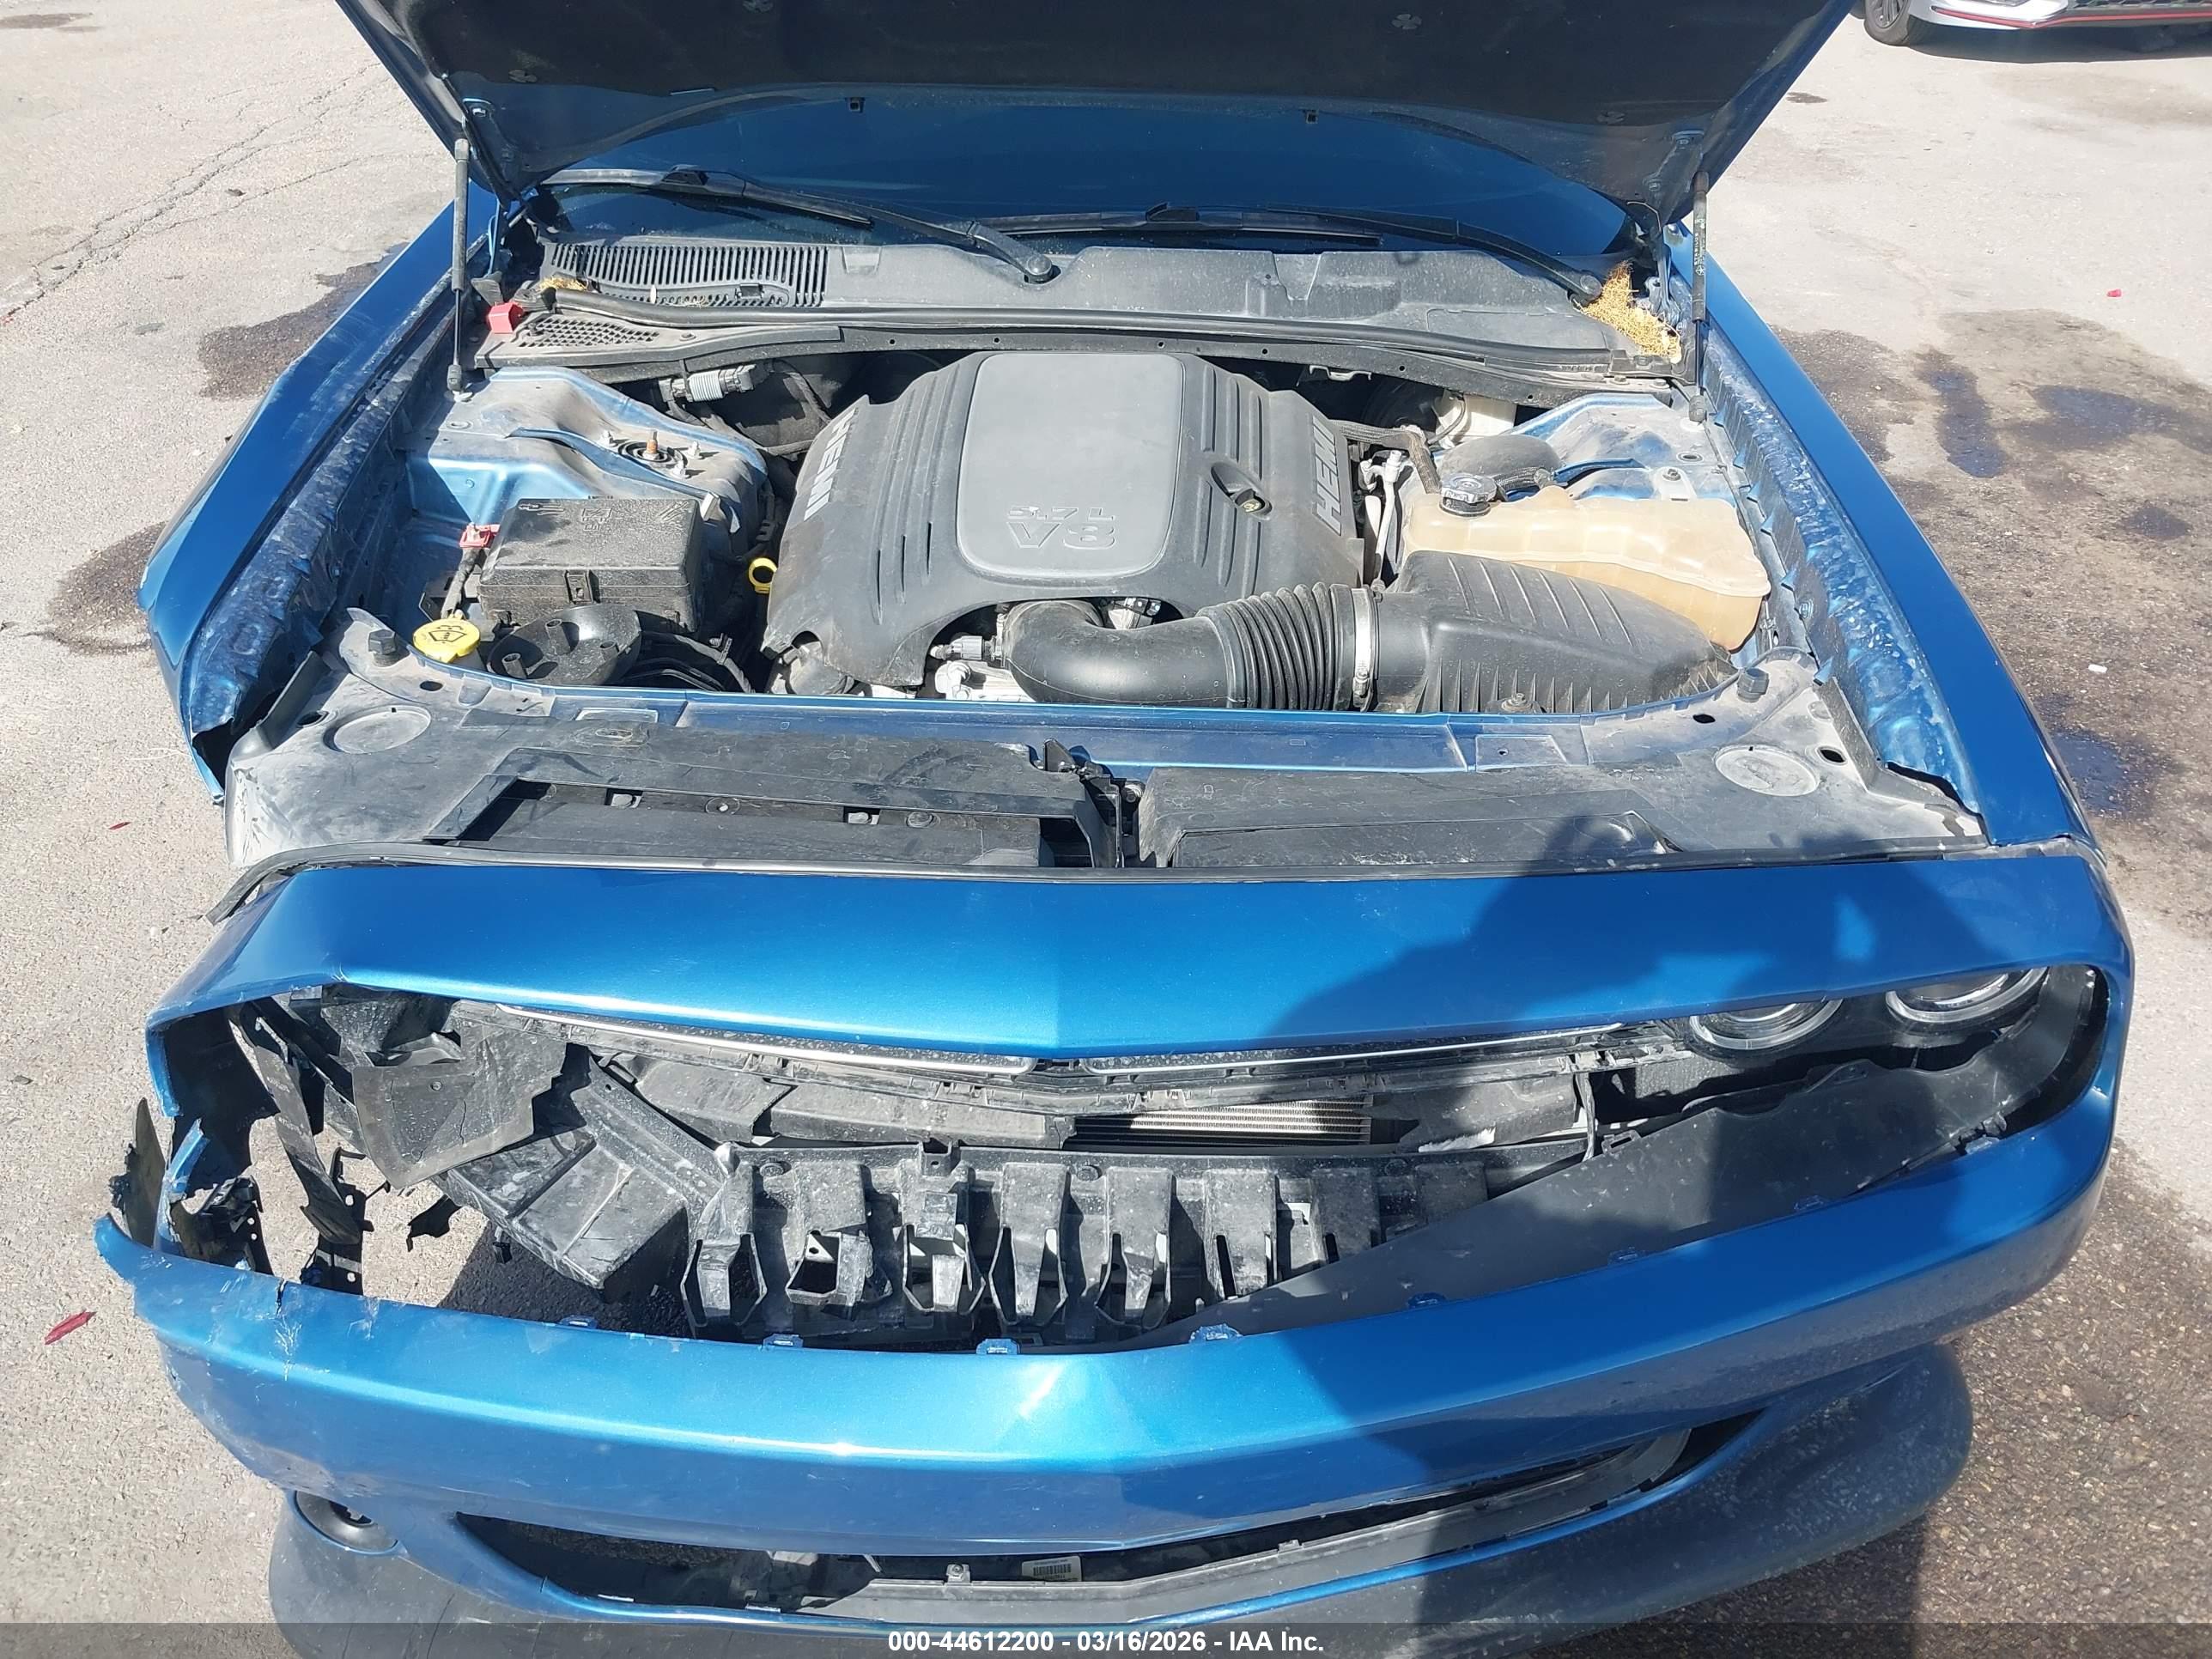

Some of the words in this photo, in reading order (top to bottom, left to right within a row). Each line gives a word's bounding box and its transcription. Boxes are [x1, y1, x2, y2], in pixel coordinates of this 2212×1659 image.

[803, 406, 858, 522] HEMI
[1312, 415, 1342, 537] HEMI
[1006, 520, 1116, 550] V8
